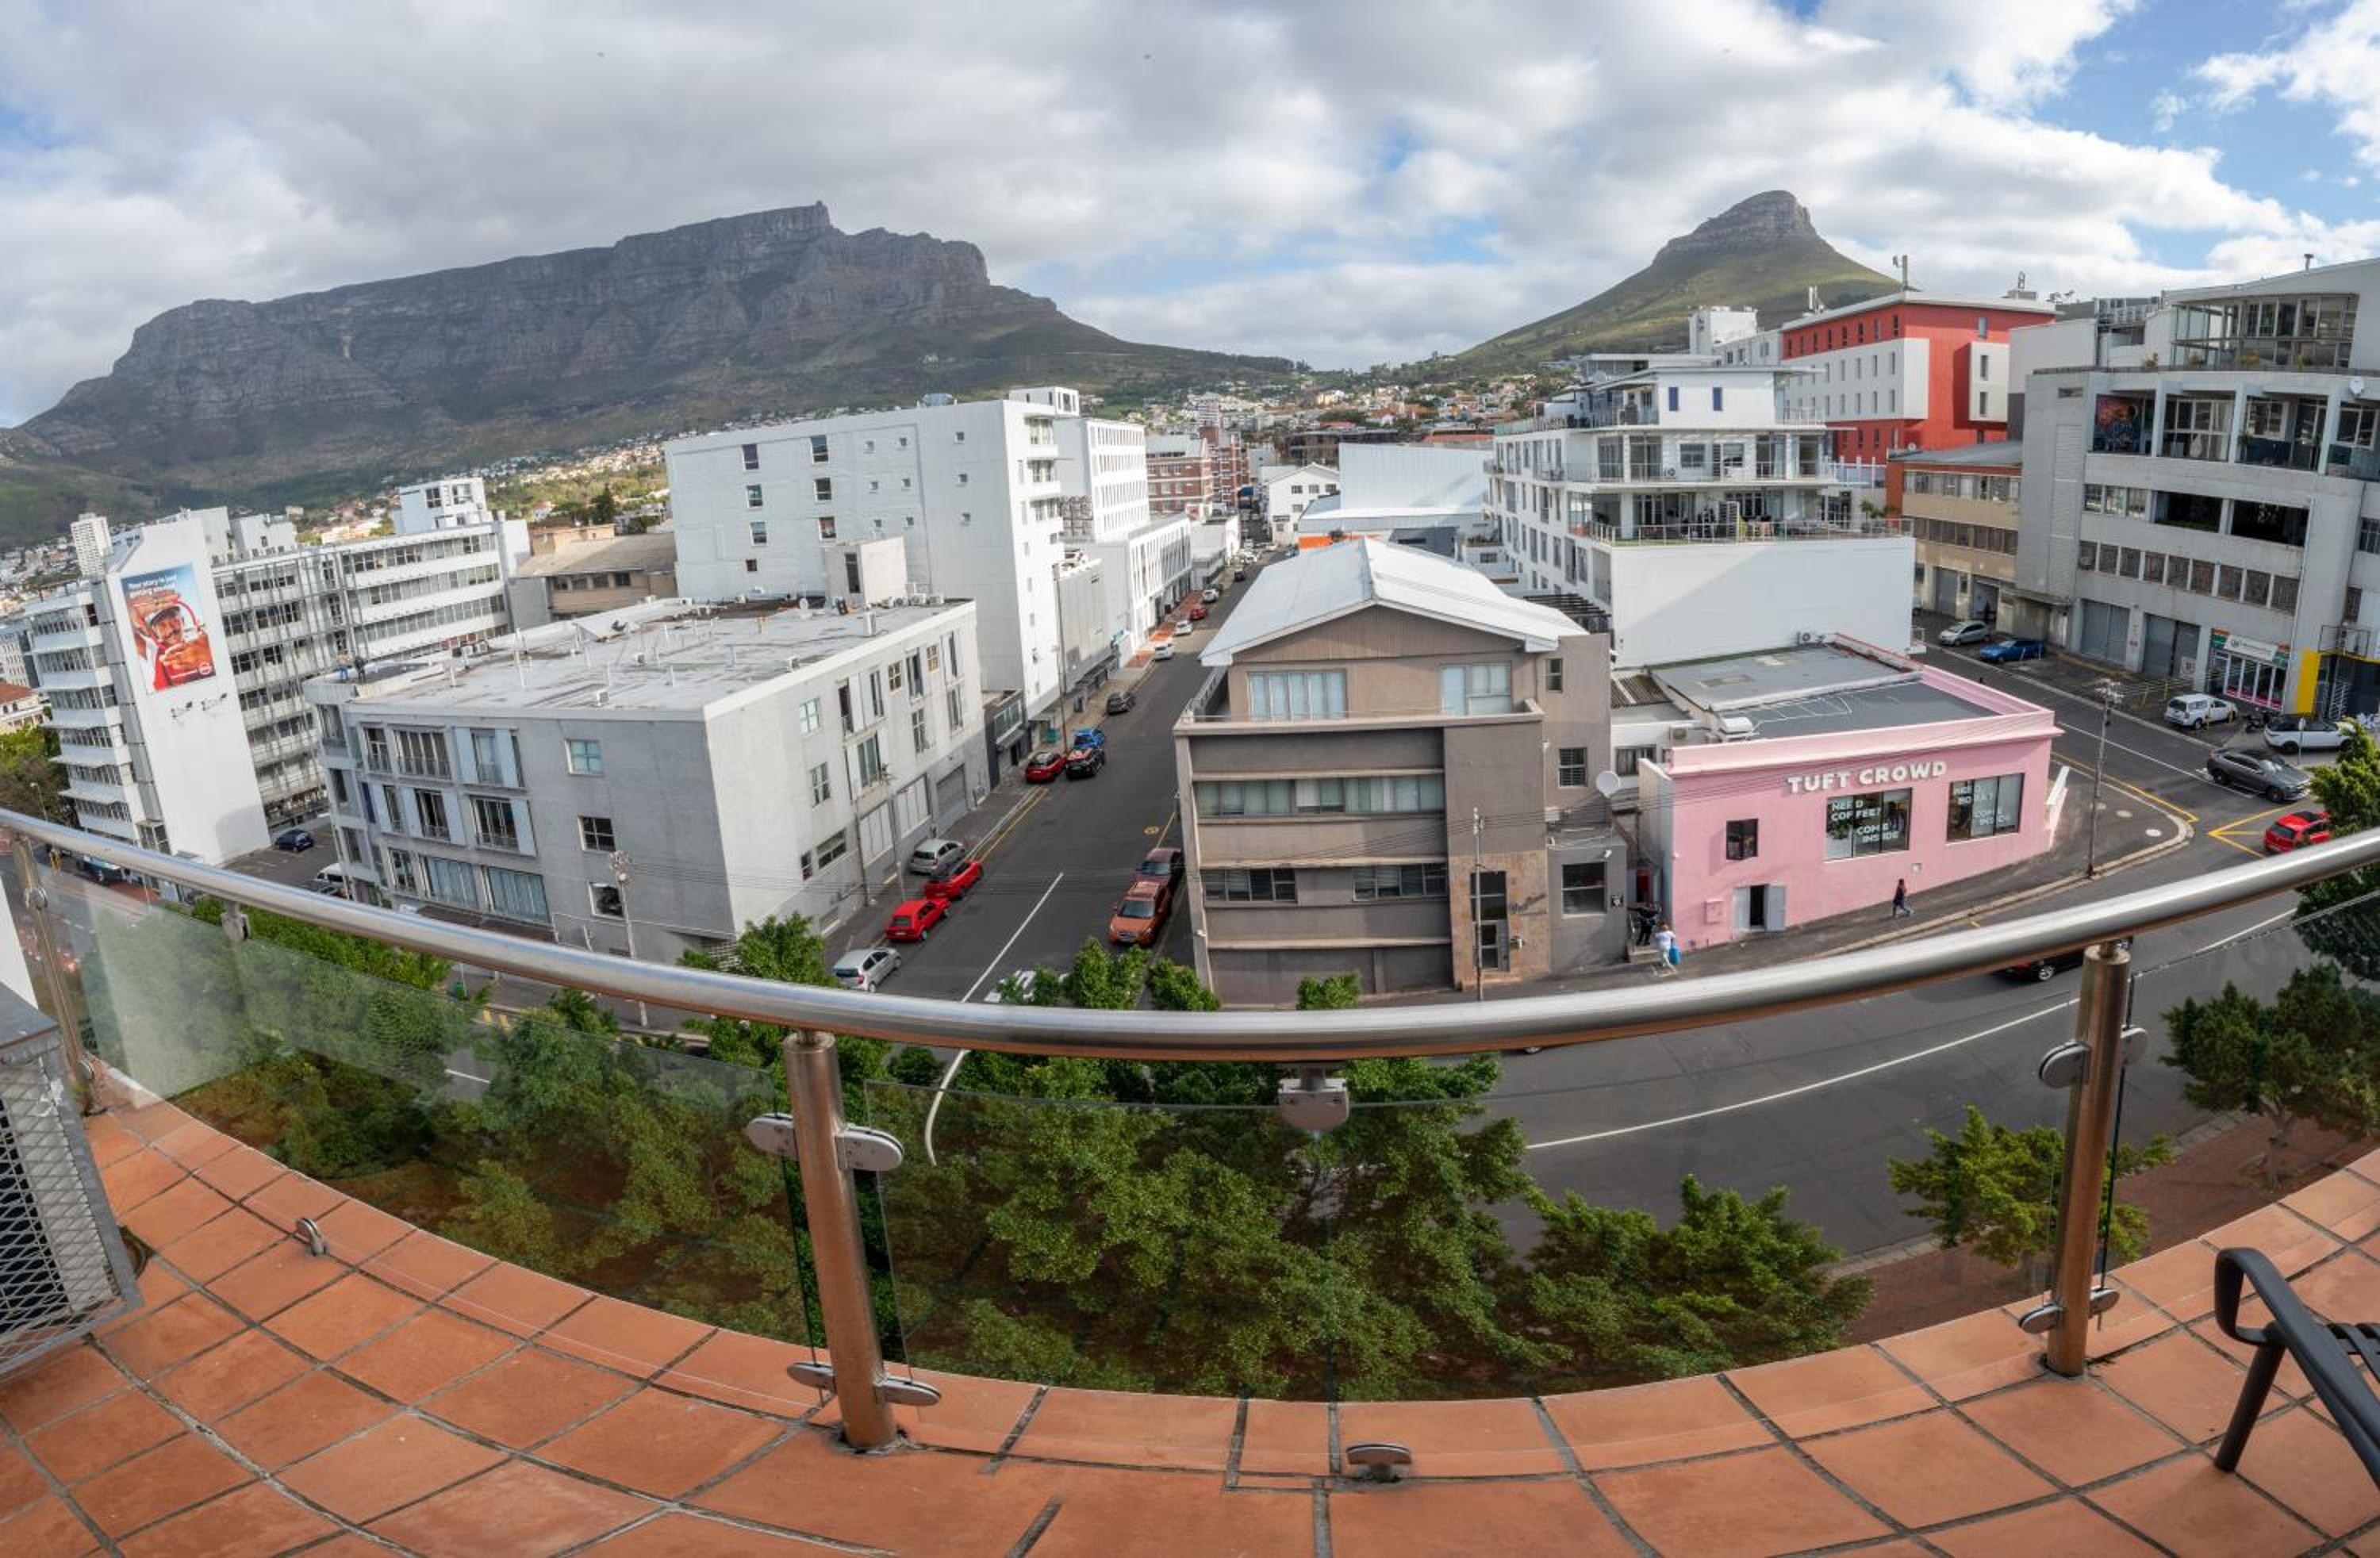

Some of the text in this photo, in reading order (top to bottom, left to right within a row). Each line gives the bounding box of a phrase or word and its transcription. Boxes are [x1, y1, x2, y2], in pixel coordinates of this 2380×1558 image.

[1787, 761, 1948, 793] TUFT CROWD
[1831, 799, 1864, 812] NEED
[1830, 808, 1882, 822] COFFEE?
[1856, 823, 1889, 835] COME
[1862, 831, 1899, 843] INSIDE
